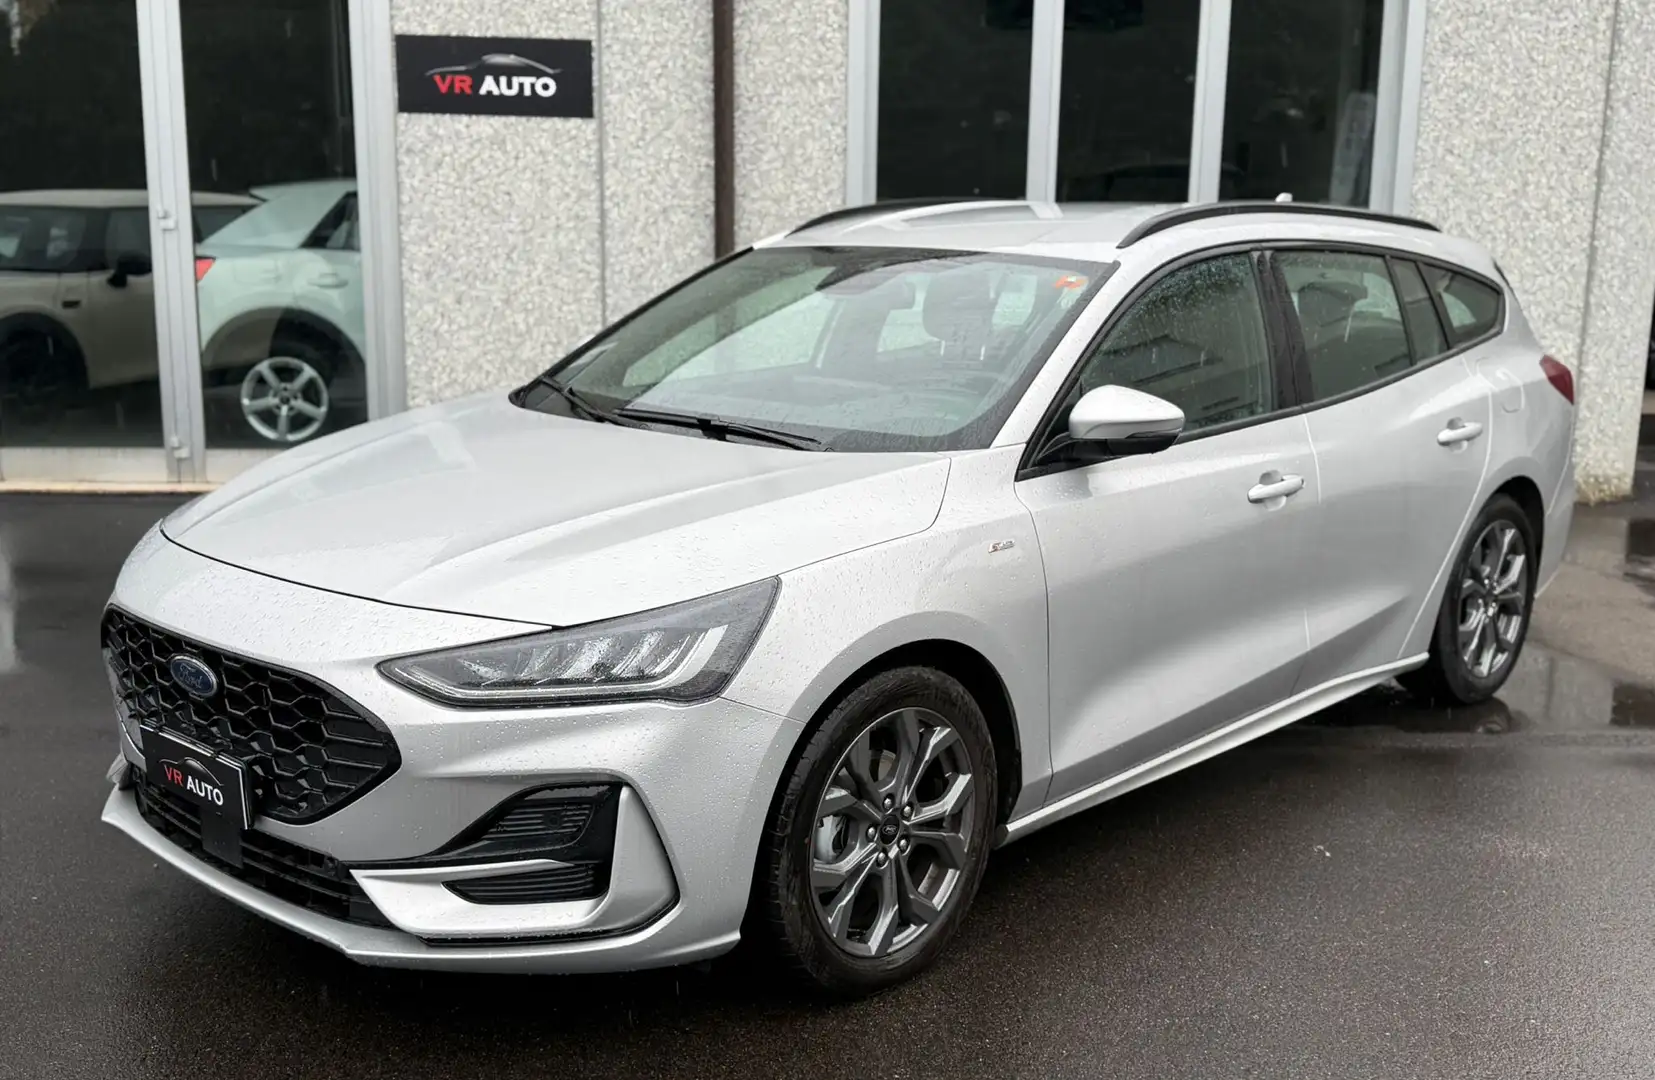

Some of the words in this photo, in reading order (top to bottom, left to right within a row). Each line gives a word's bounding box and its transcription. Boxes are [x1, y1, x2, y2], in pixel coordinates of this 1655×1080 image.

[433, 73, 472, 95] VR
[478, 75, 557, 98] AUTO
[164, 764, 183, 787] VR
[186, 775, 224, 806] AUTO
